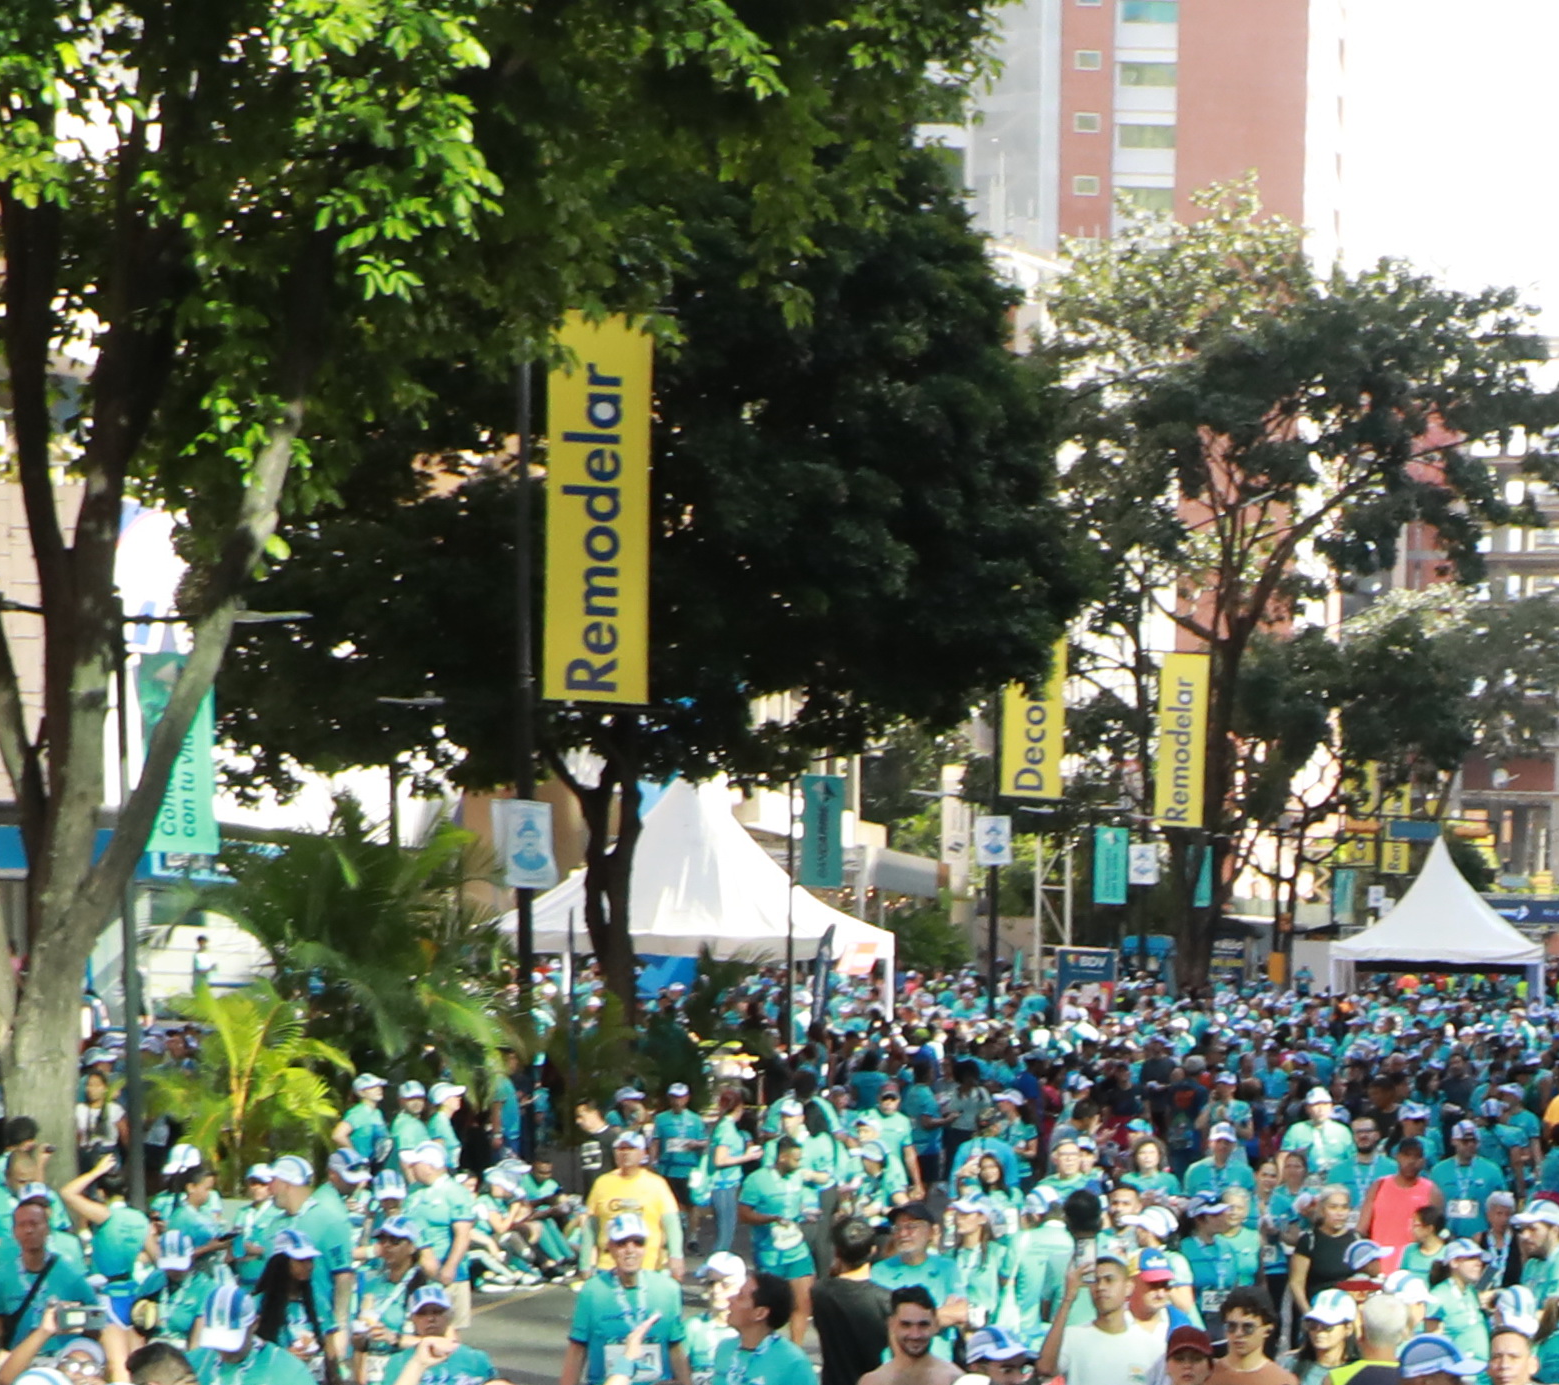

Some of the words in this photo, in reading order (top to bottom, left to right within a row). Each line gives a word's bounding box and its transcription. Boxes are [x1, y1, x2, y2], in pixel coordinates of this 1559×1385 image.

[561, 362, 624, 693] Remodelar
[181, 798, 197, 838] con
[1165, 677, 1195, 822] Remodelar
